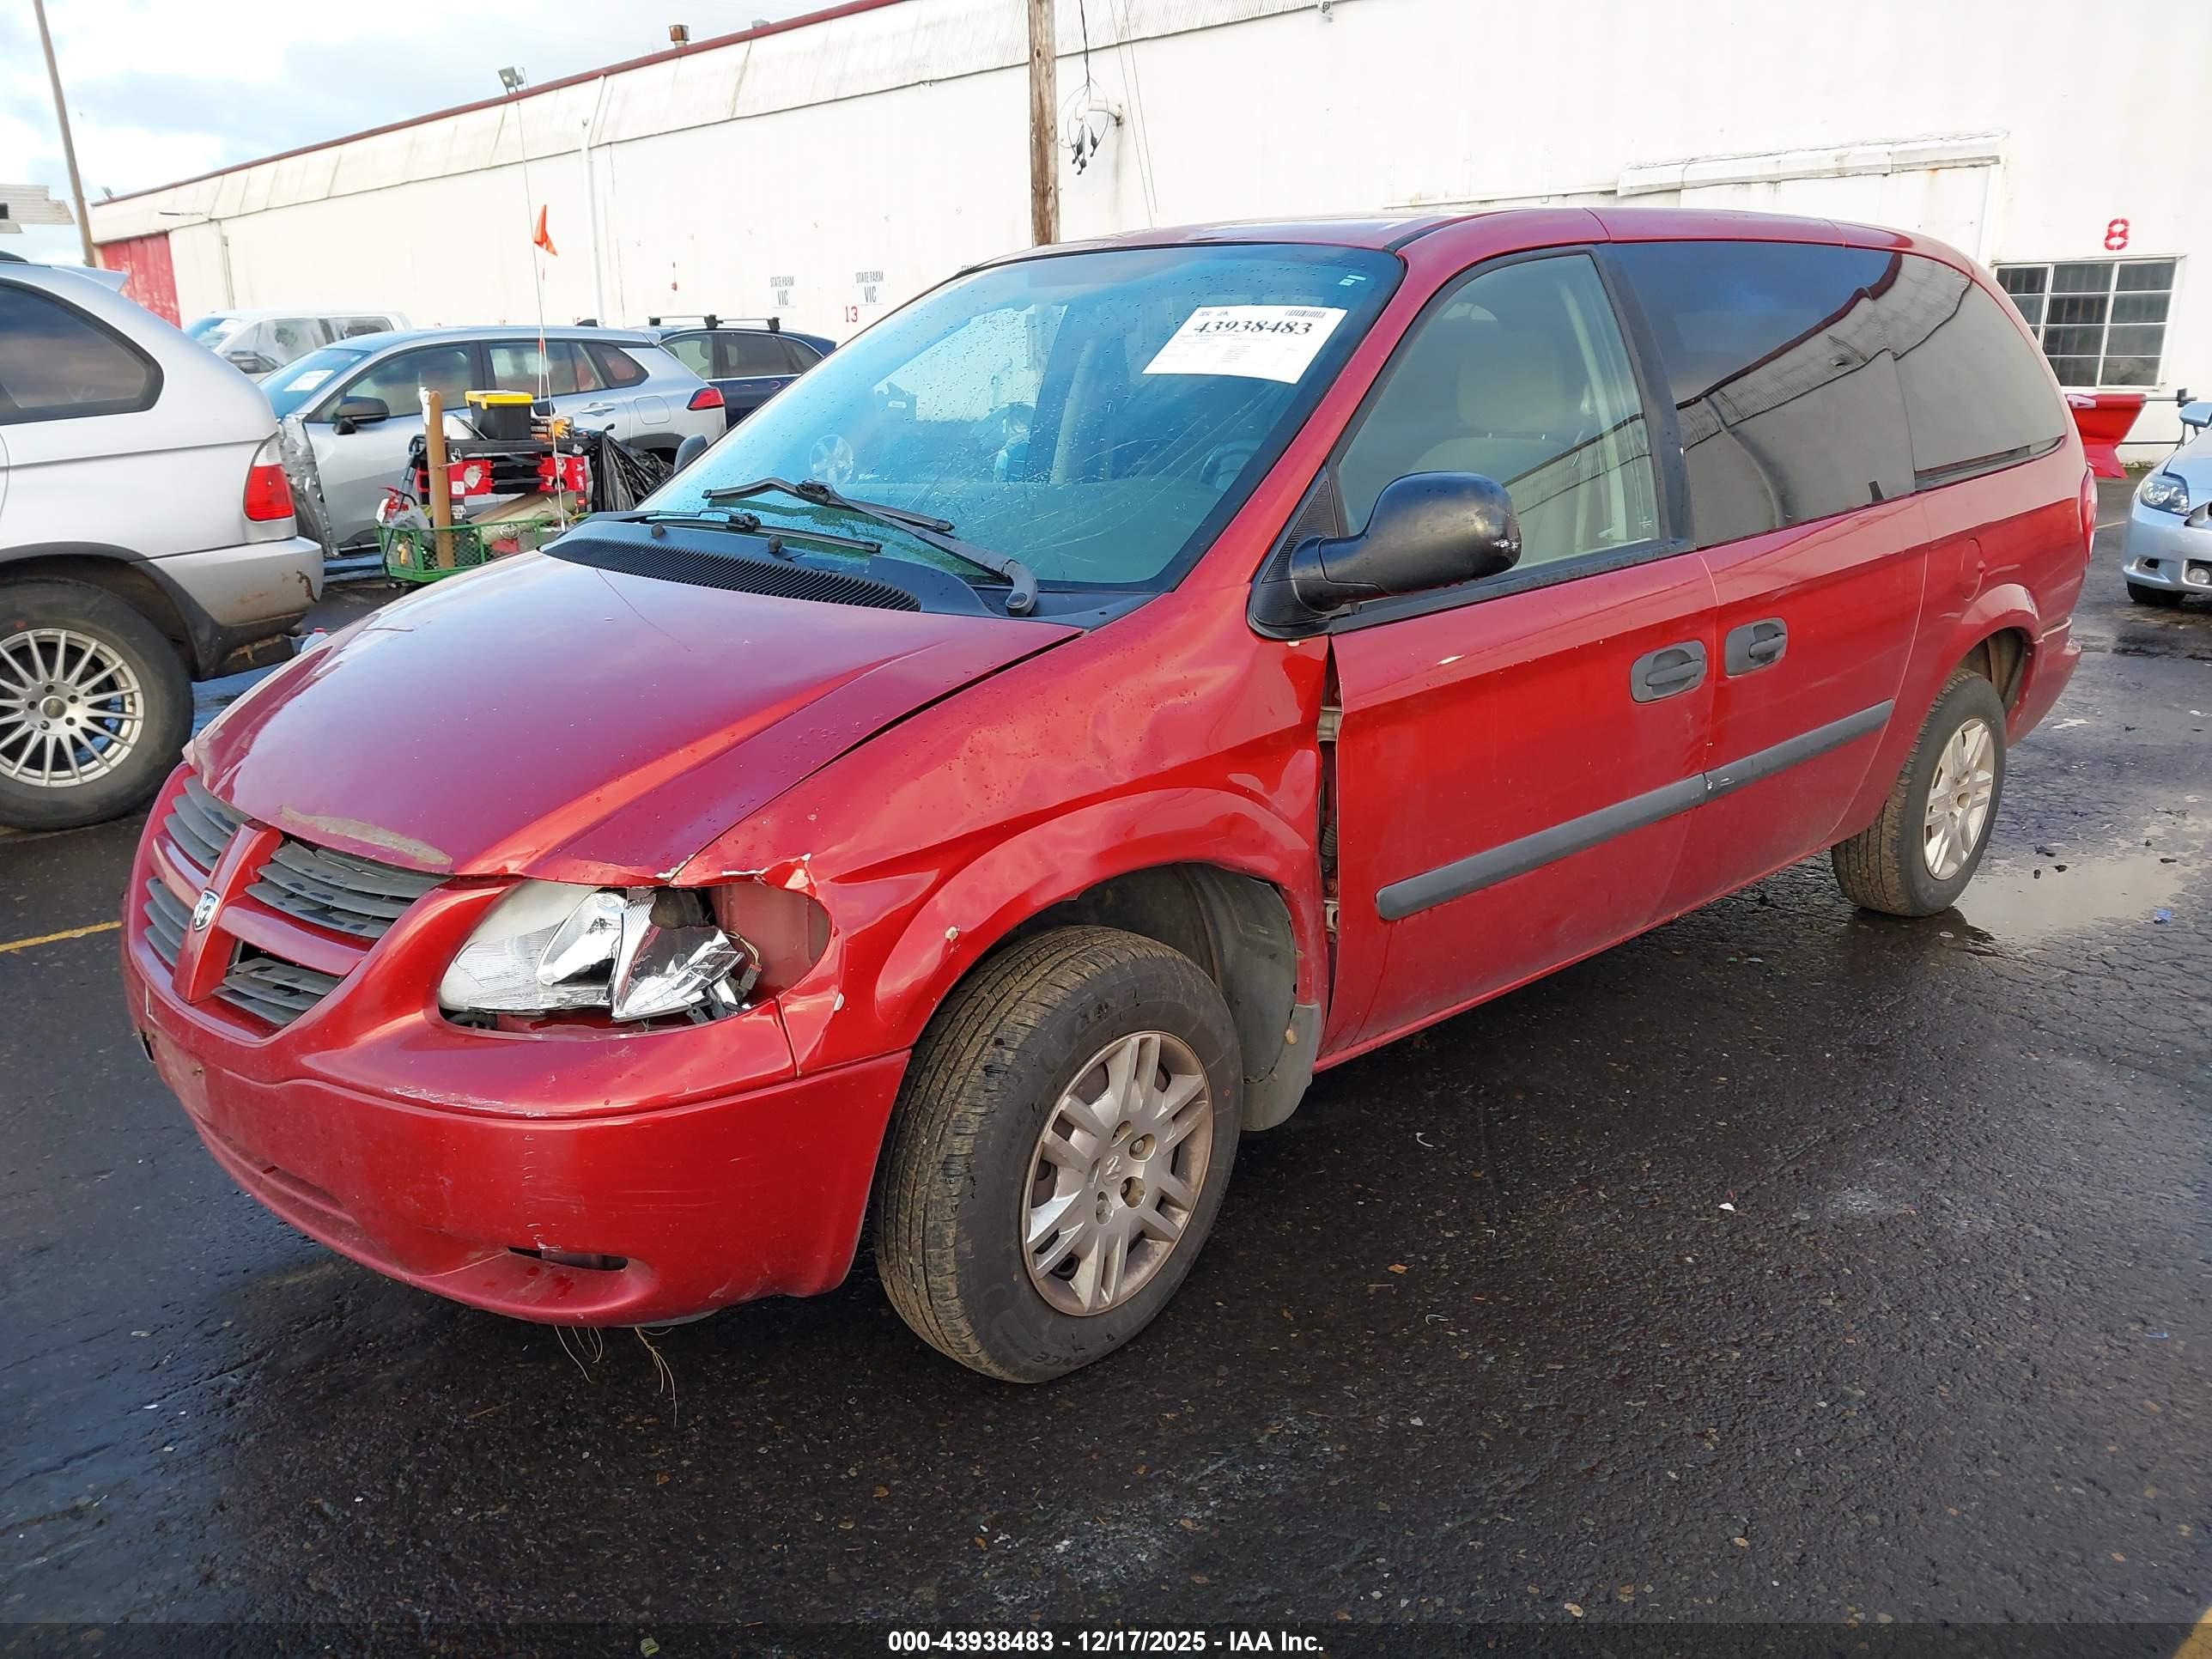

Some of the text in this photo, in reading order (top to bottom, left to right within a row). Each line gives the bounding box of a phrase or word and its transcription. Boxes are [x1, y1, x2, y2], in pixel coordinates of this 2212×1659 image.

[2104, 218, 2130, 251] 8
[777, 289, 788, 306] VIC
[864, 285, 877, 302] VIC
[845, 305, 858, 323] 13
[1194, 319, 1313, 336] 43938483
